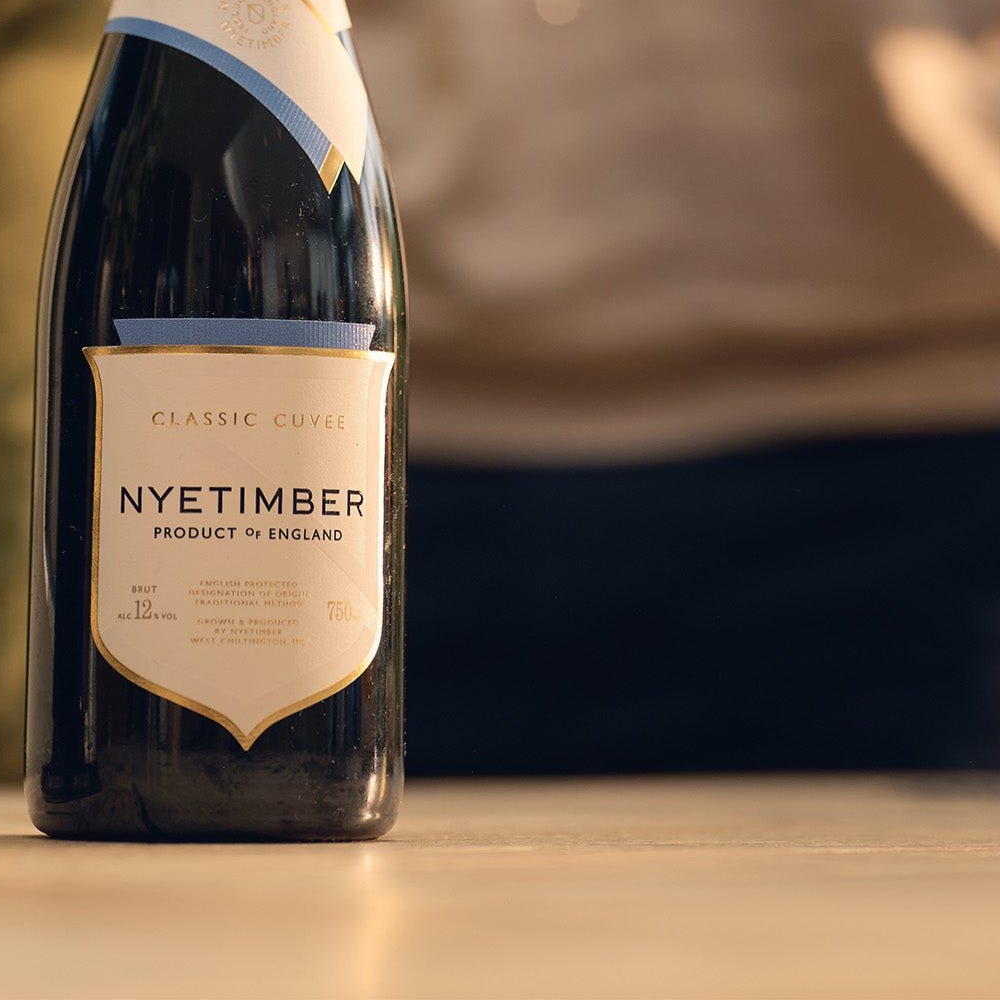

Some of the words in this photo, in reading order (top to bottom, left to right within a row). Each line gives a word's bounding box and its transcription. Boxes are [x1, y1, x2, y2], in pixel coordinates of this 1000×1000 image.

[220, 20, 291, 50] NYETIMBER
[151, 411, 258, 428] CLASSIC
[273, 412, 346, 430] CUVEE
[119, 486, 364, 517] NYETIMBER
[153, 526, 238, 540] PRODUCT
[268, 528, 344, 542] ENGLAND
[131, 585, 158, 594] BRUT
[200, 580, 241, 588] ENGLISH
[117, 612, 132, 620] ALC
[161, 612, 178, 620] VOL
